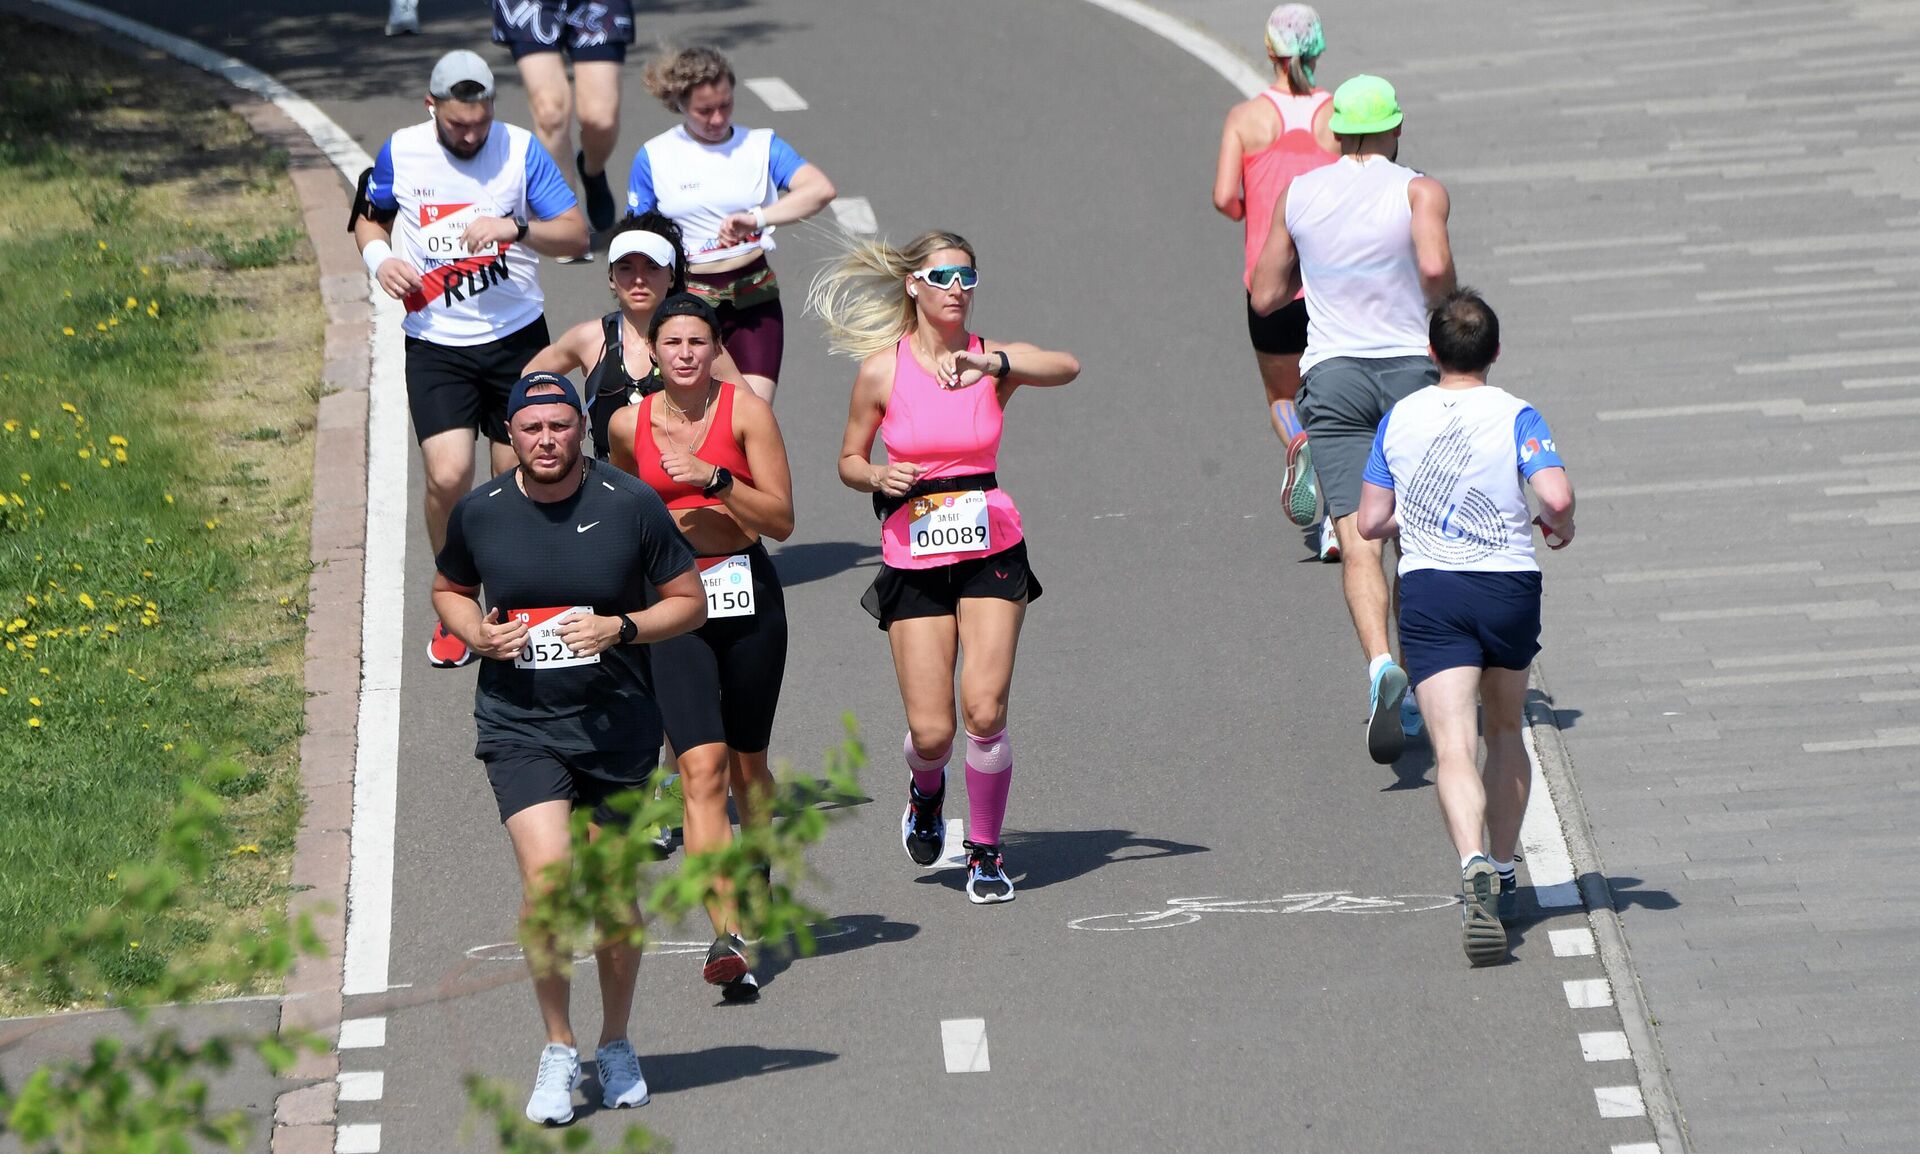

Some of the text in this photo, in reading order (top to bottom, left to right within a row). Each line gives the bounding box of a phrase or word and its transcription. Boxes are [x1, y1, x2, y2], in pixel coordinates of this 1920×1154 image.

[425, 206, 439, 217] 10
[444, 252, 510, 309] RUN
[917, 525, 986, 548] 00089
[708, 590, 750, 610] 150
[515, 612, 530, 623] 10
[520, 643, 576, 663] 052
